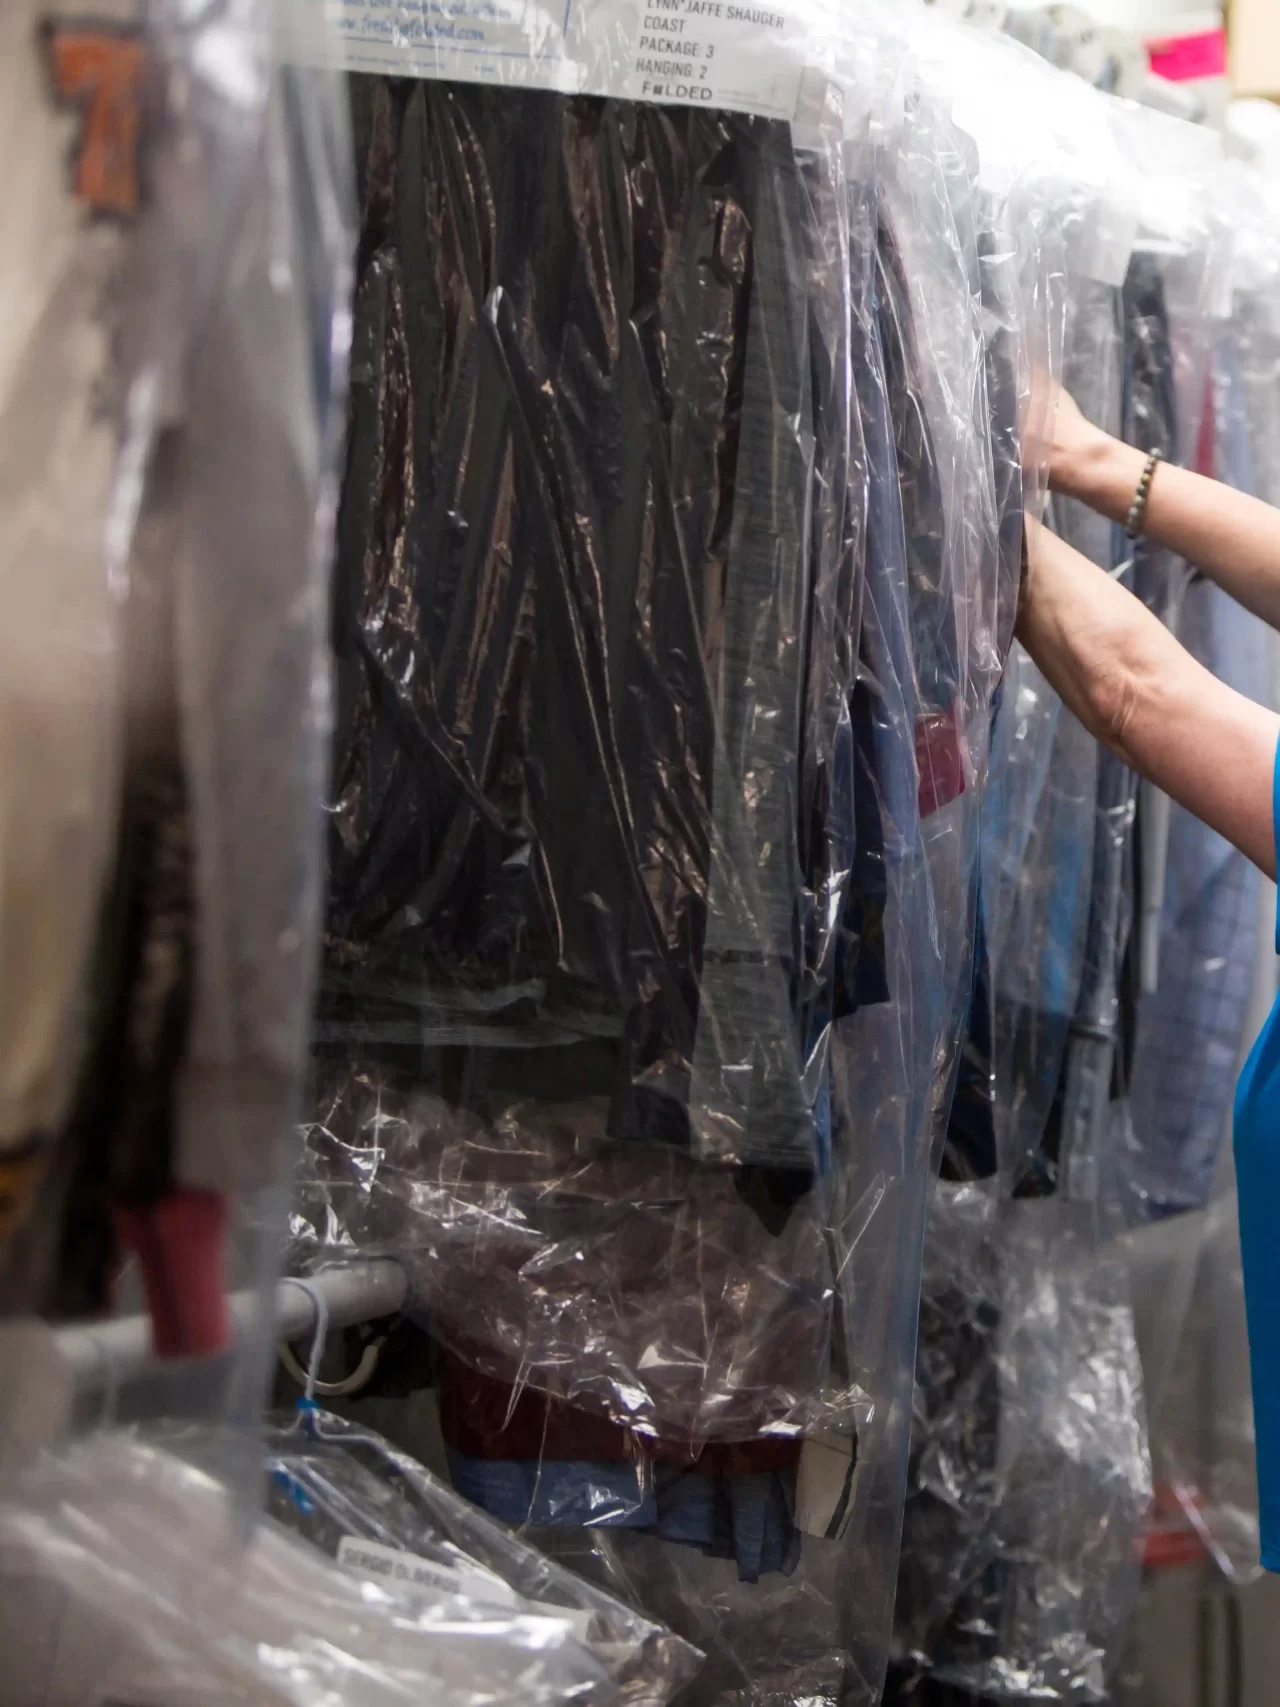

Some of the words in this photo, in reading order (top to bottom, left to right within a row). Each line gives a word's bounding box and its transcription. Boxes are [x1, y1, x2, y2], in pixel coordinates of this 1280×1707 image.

[643, 15, 686, 33] COAST
[706, 44, 715, 59] 3
[699, 64, 708, 80] 2
